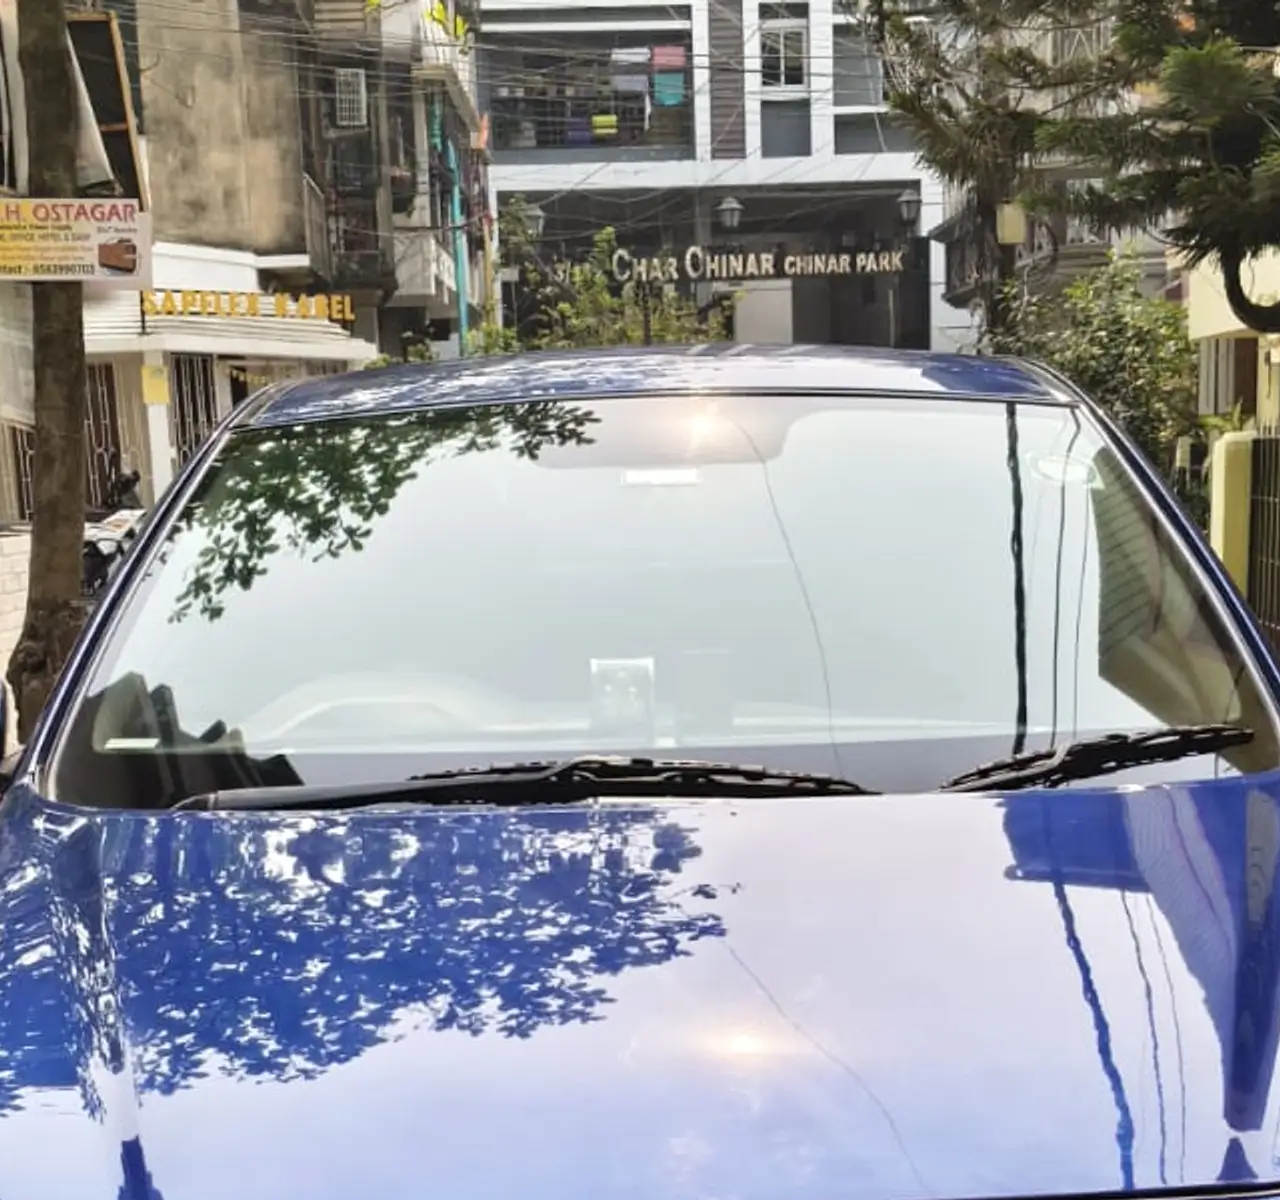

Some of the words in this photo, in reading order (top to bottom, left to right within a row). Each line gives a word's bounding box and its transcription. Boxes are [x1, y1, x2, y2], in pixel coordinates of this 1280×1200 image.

[32, 203, 137, 222] OSTAGAR
[612, 249, 679, 281] CHAR
[685, 246, 774, 279] CHINAR
[784, 253, 851, 276] CHINAR
[856, 251, 904, 273] PARK
